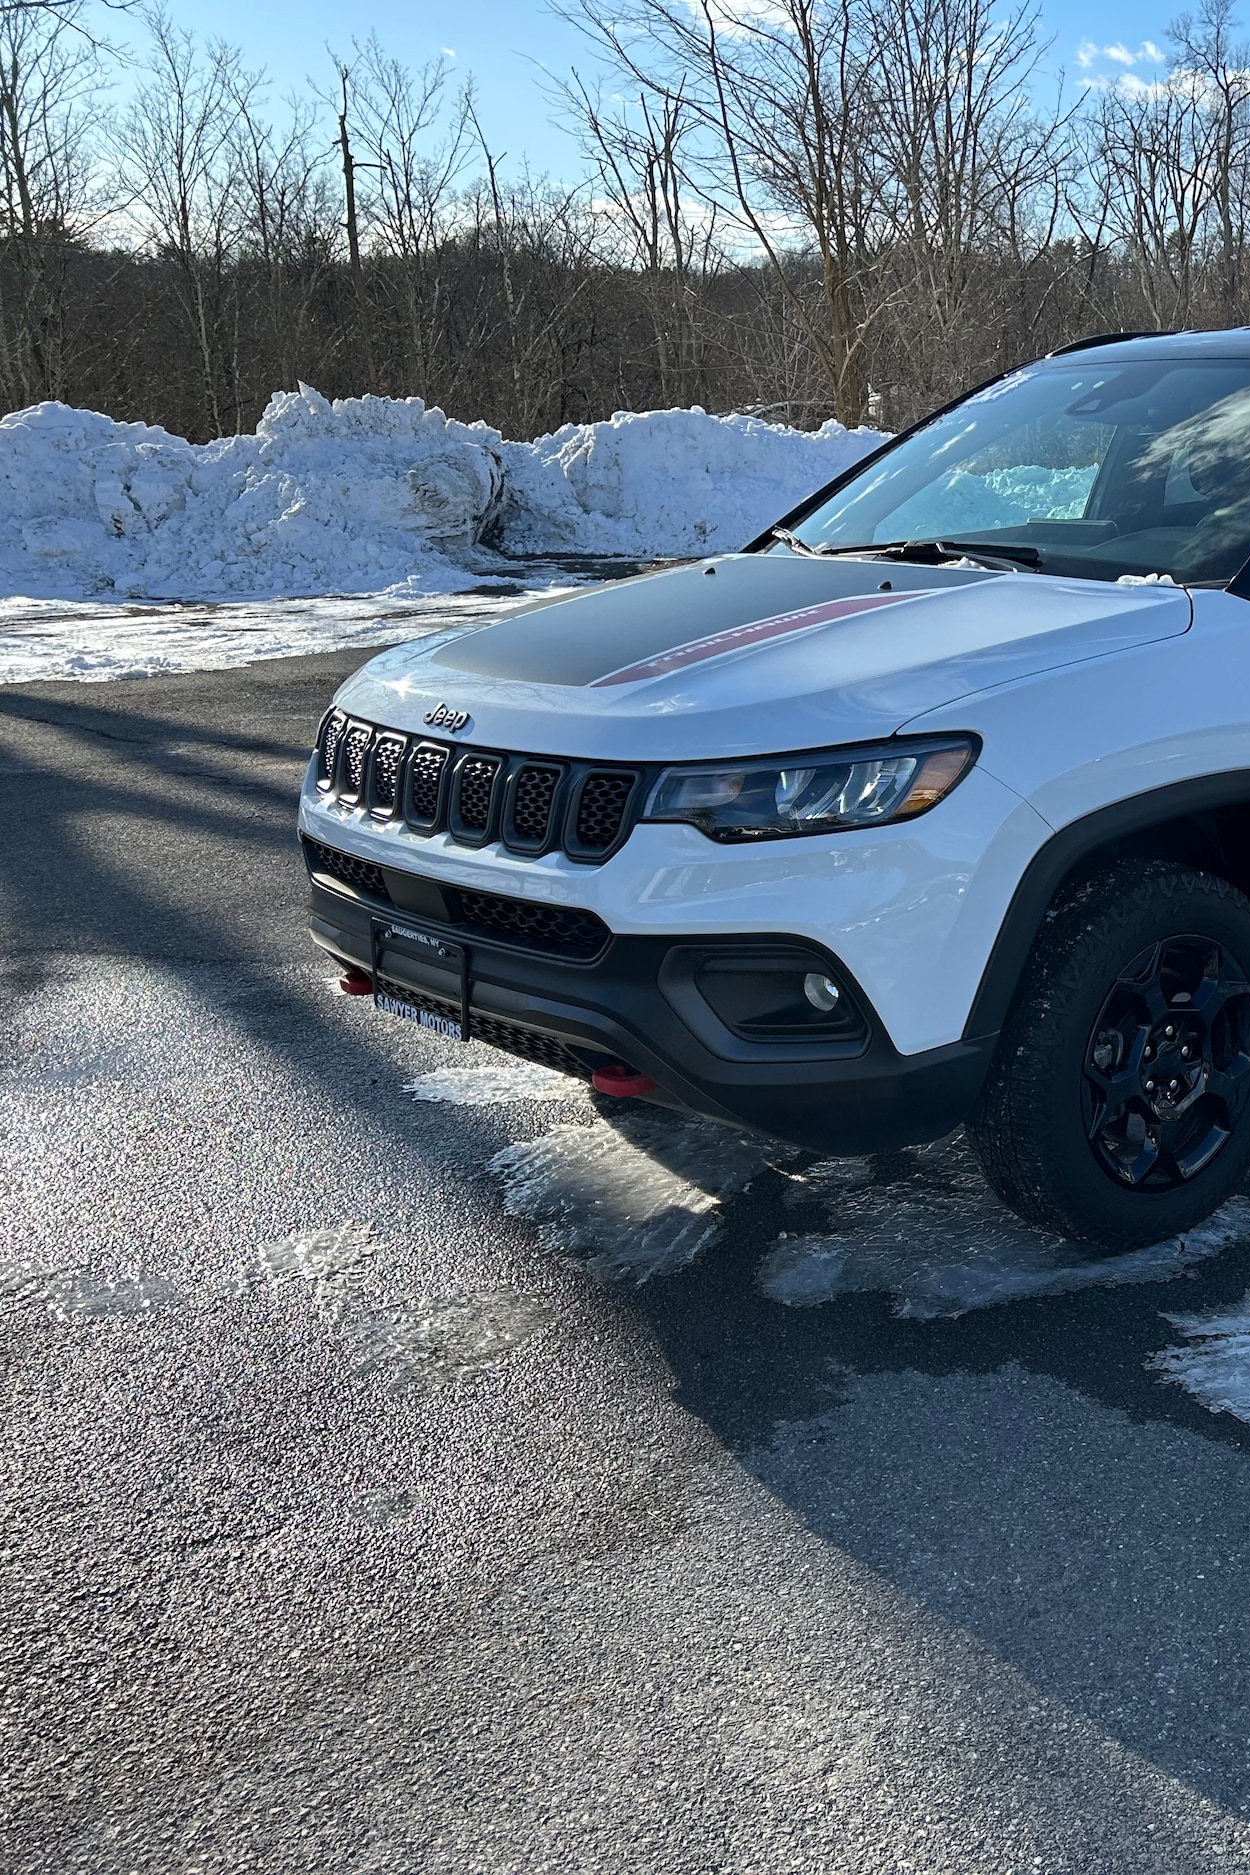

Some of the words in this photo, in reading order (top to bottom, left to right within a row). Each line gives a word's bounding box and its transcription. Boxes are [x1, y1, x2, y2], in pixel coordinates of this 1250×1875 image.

[638, 609, 822, 669] TRAILHAWK
[423, 701, 468, 734] Jeep
[376, 994, 418, 1023] SAWYER
[420, 1011, 462, 1040] MOTORS
